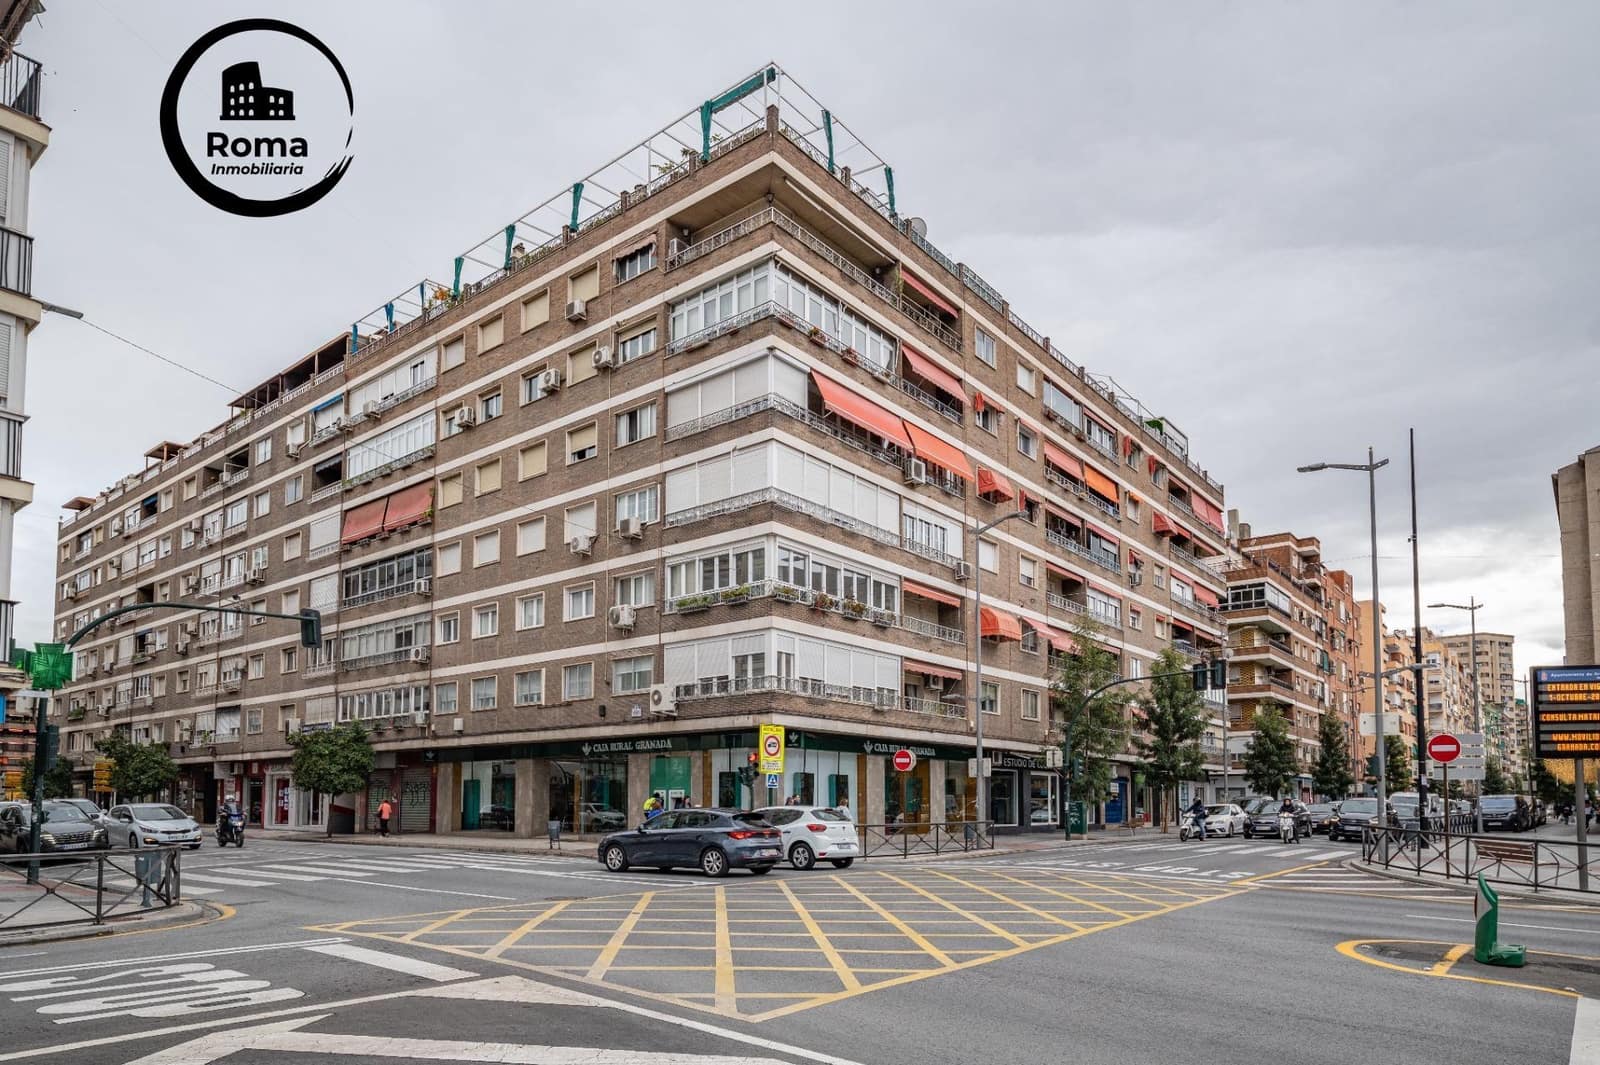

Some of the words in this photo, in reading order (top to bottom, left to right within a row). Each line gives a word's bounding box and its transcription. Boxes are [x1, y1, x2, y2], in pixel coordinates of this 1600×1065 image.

[1543, 713, 1577, 721] CONSULTA
[610, 742, 633, 751] RURAL
[635, 739, 672, 750] GRANADA
[1003, 757, 1028, 768] ESTUDIO
